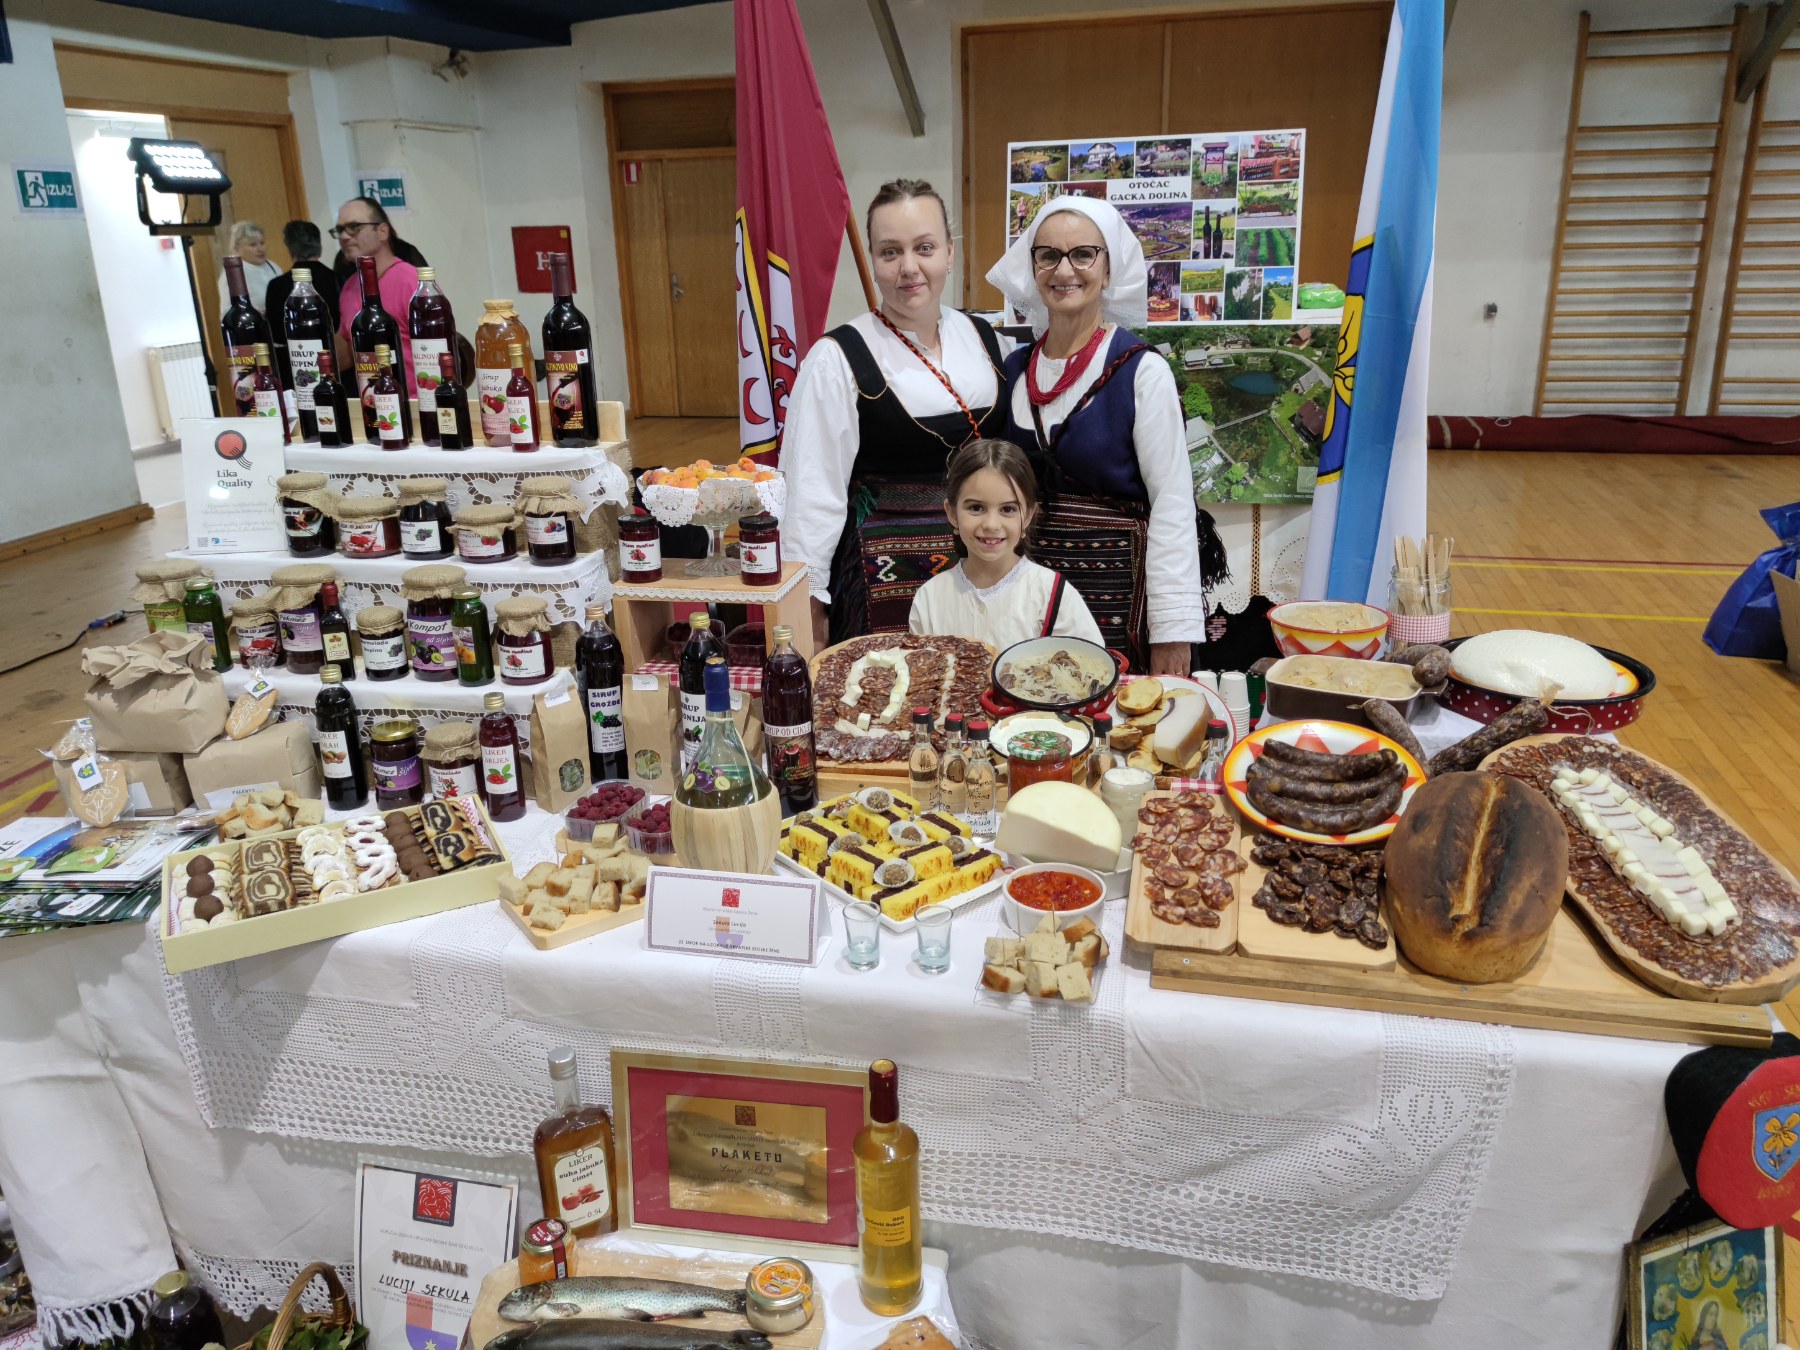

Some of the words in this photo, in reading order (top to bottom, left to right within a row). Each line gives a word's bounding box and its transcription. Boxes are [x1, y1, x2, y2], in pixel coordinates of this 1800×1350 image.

[46, 184, 74, 196] IZLAZ
[1110, 193, 1145, 202] GACKA
[1148, 191, 1188, 201] DOLINA
[291, 349, 315, 359] SIRUP
[216, 469, 238, 479] Lika
[217, 479, 254, 491] Quality
[148, 608, 179, 617] Kompot
[409, 620, 447, 634] Kompot
[592, 689, 617, 698] SIRUP
[568, 1153, 594, 1168] LIKER
[711, 1147, 782, 1163] PLAKETU
[559, 1169, 578, 1180] suha
[579, 1159, 604, 1175] jabuka
[572, 1171, 593, 1184] cimet
[391, 1249, 469, 1279] PRIZNANJE
[378, 1273, 416, 1294] LUCIJI
[421, 1283, 471, 1303] SEKULA
